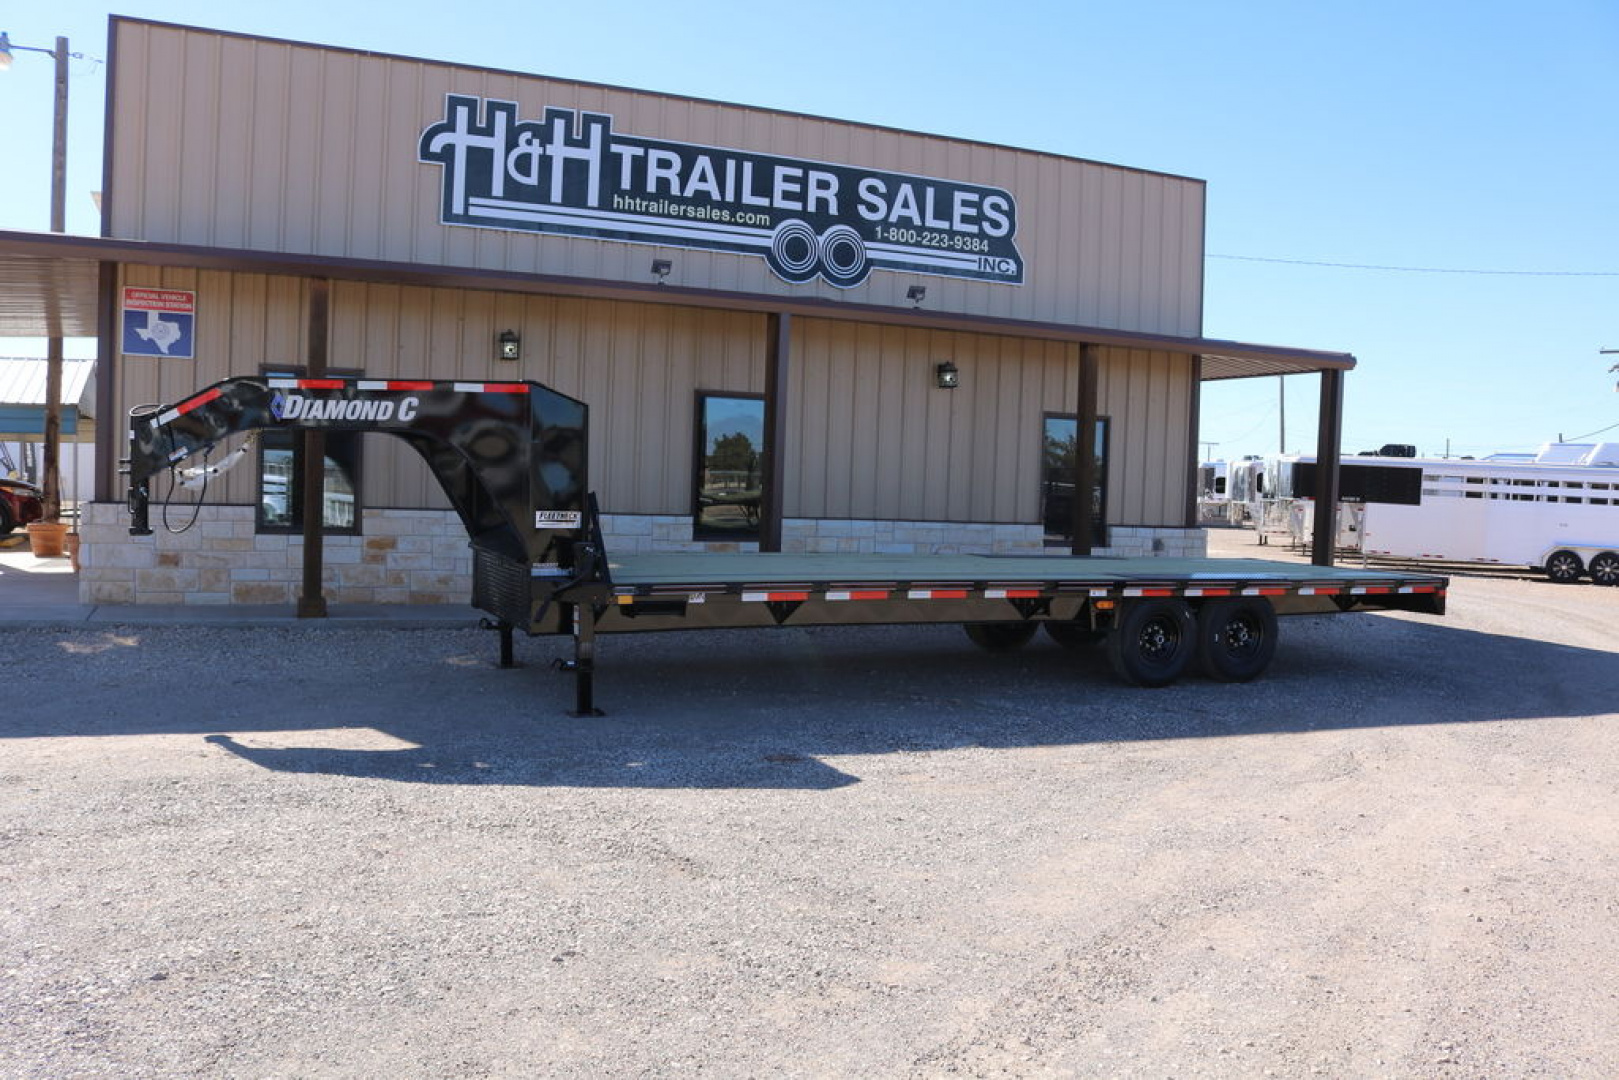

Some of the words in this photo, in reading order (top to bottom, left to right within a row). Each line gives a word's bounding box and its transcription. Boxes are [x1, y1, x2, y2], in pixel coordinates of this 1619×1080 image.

[430, 106, 602, 215] H&H
[610, 143, 839, 216] TRAILER
[857, 178, 1010, 237] SALES
[613, 194, 770, 226] hhtrailersales.com
[875, 226, 989, 252] 1-800-223-9384
[978, 257, 1016, 275] INC.
[282, 395, 394, 420] DIAMOND
[397, 396, 420, 422] C
